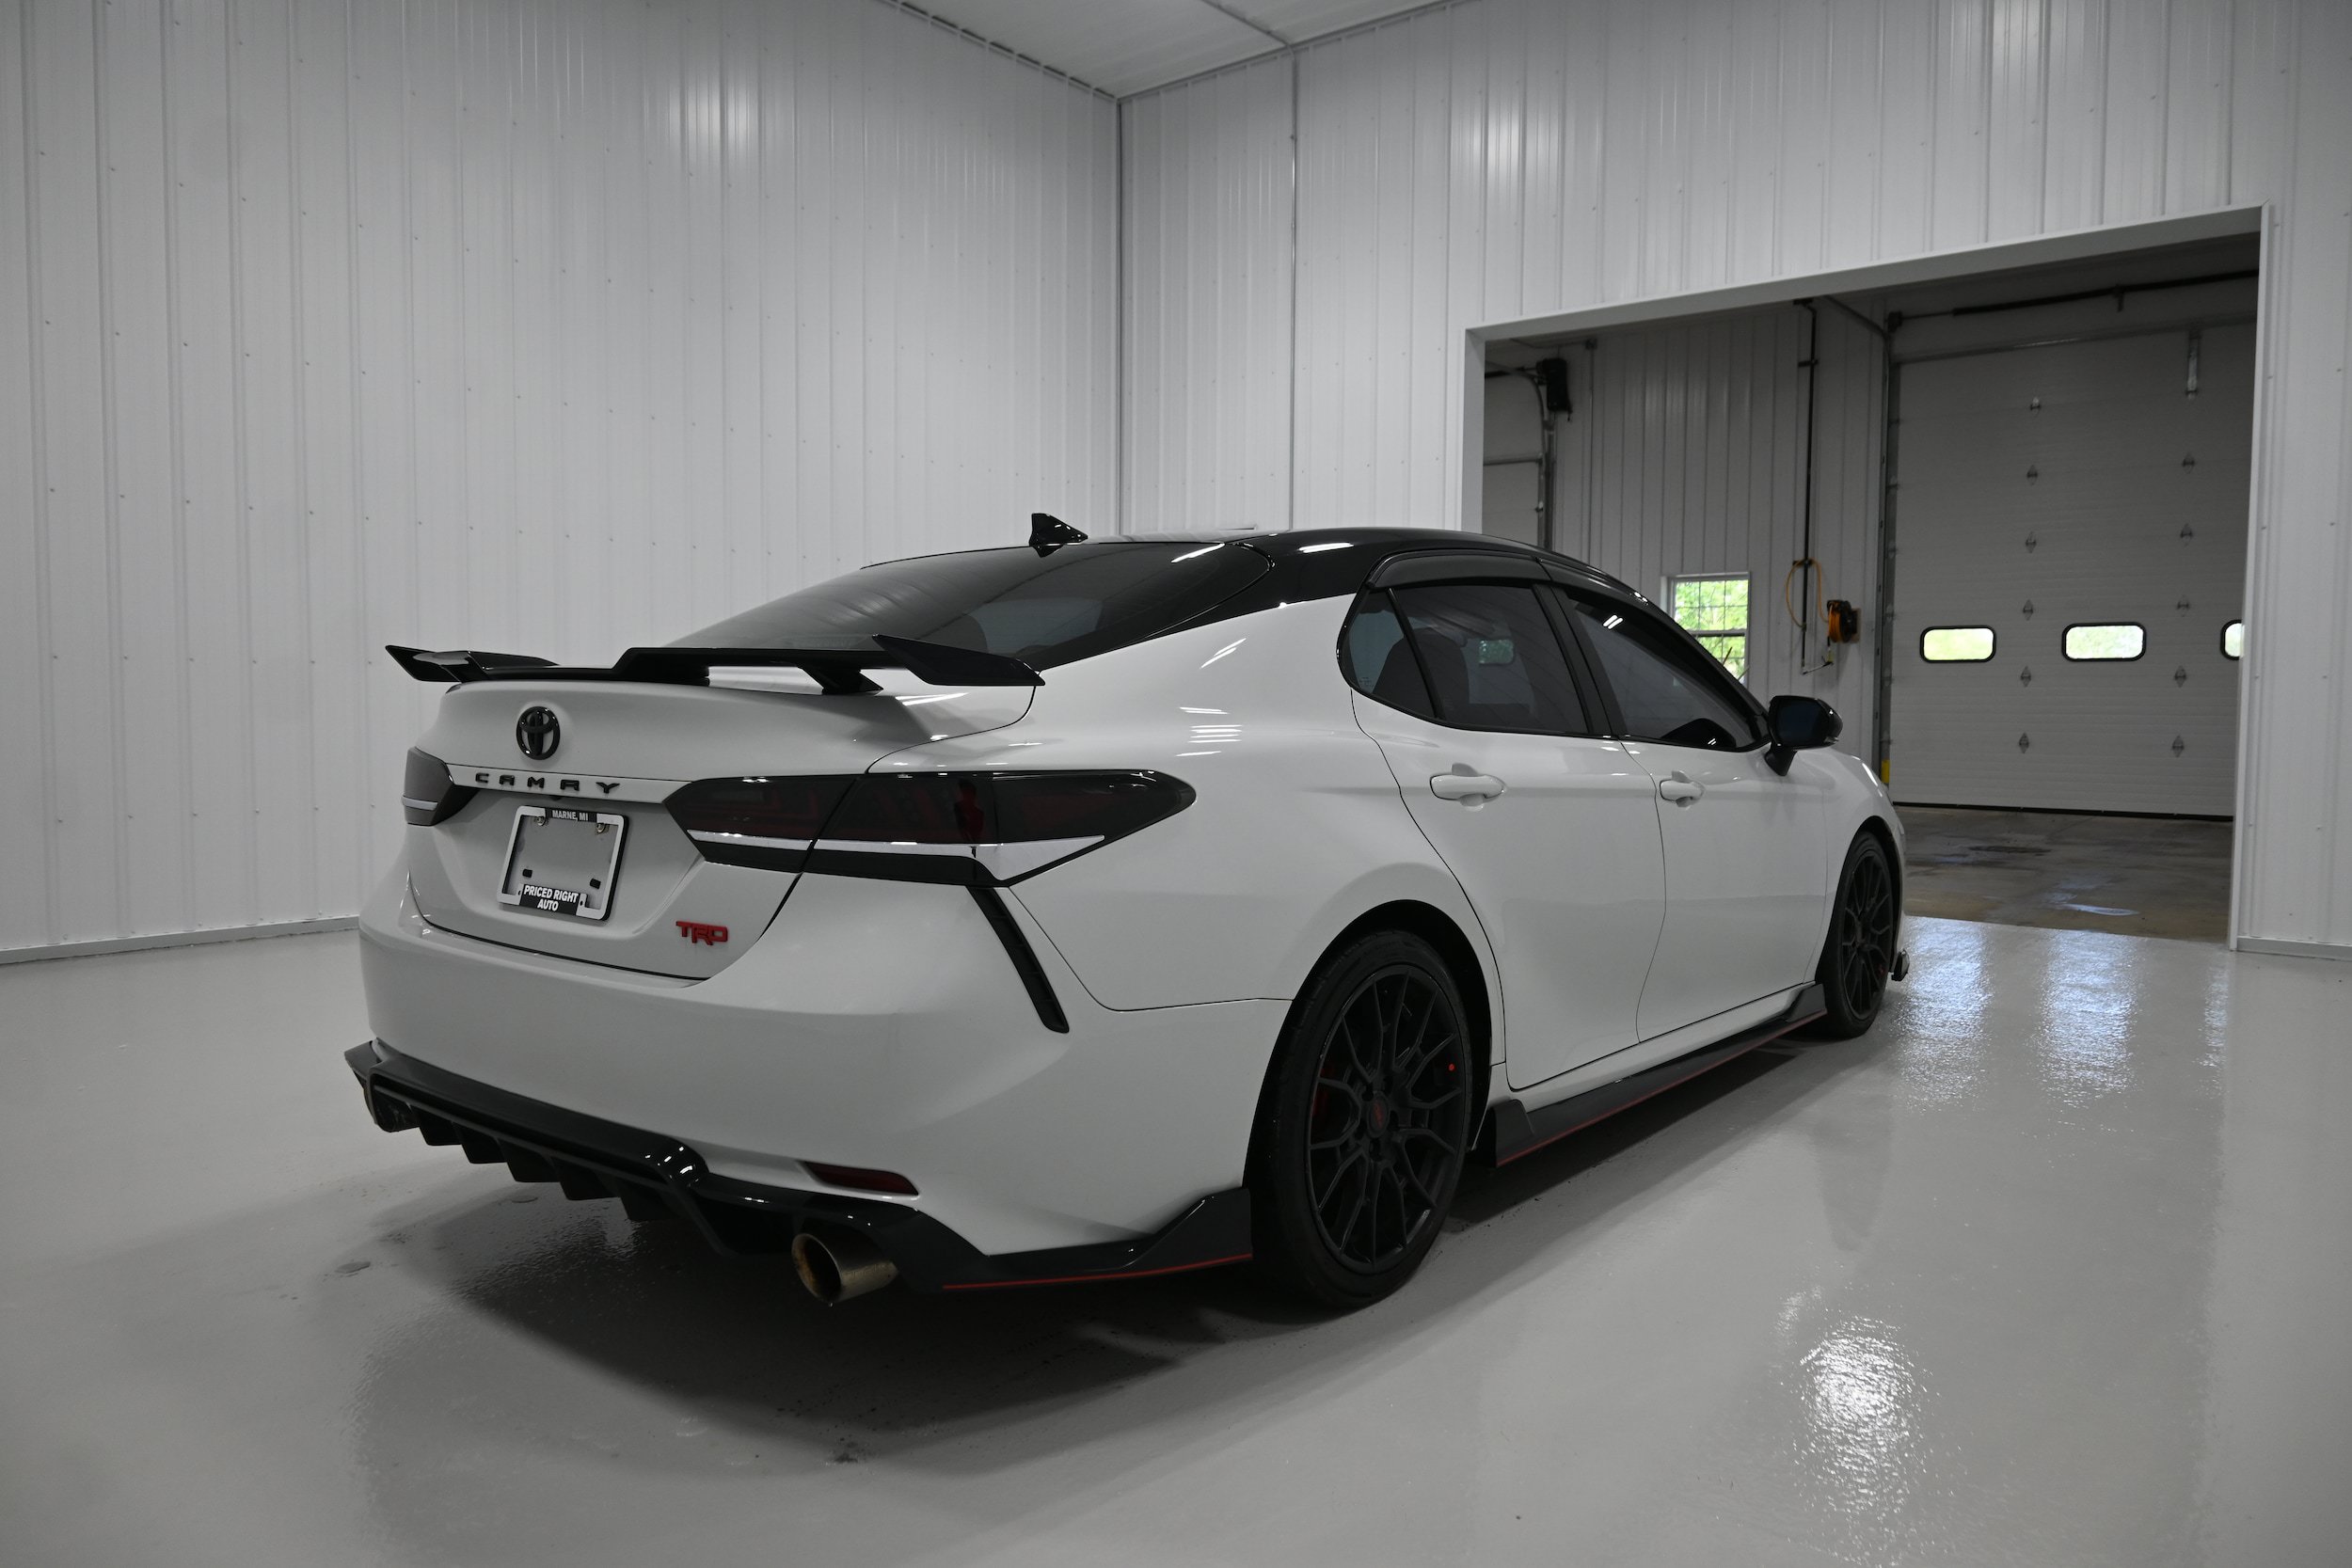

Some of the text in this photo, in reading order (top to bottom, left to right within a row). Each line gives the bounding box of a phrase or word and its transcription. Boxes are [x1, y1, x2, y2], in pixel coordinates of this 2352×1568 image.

[475, 772, 621, 794] CAMRY
[552, 810, 588, 821] MARNE, MI
[523, 885, 579, 903] PRICED RIGHT
[537, 898, 559, 911] AUTO
[675, 920, 729, 945] TRD
